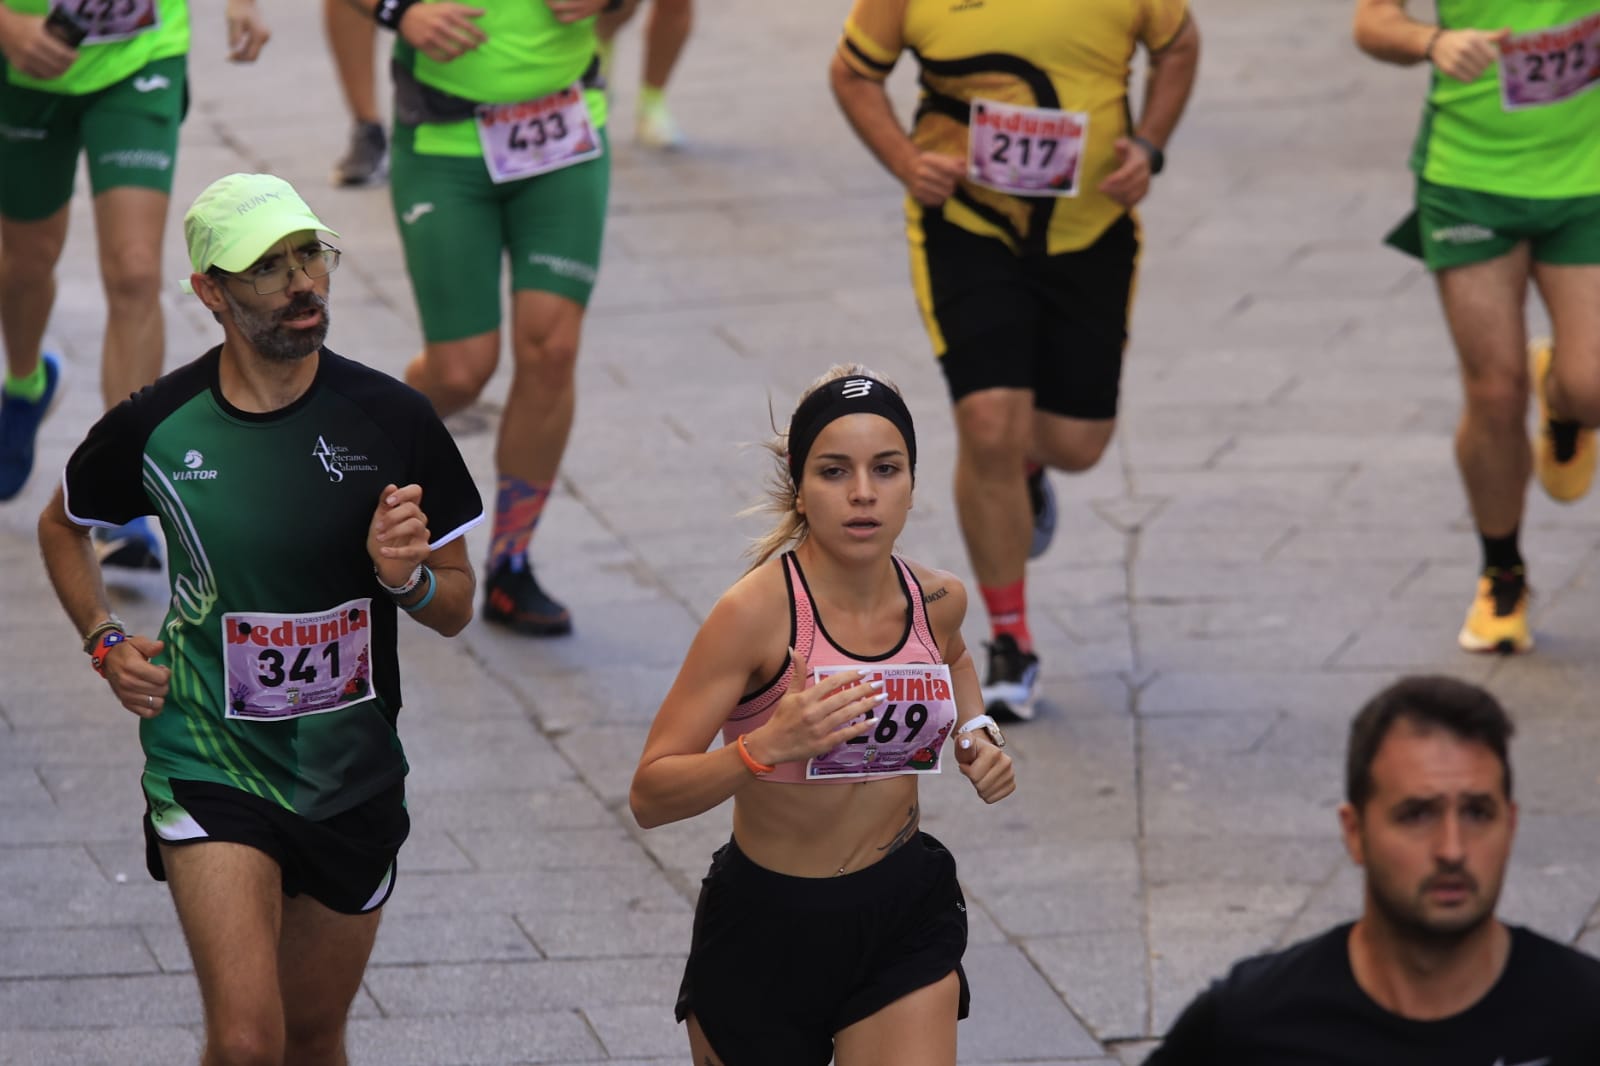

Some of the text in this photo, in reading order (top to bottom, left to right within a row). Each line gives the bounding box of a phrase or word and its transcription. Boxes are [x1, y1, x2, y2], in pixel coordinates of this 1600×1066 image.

[508, 112, 568, 151] 433
[991, 133, 1059, 168] 217
[172, 470, 218, 481] VIATOR
[329, 461, 378, 483] Salamanca
[226, 608, 367, 647] bedunia
[258, 641, 340, 688] 341
